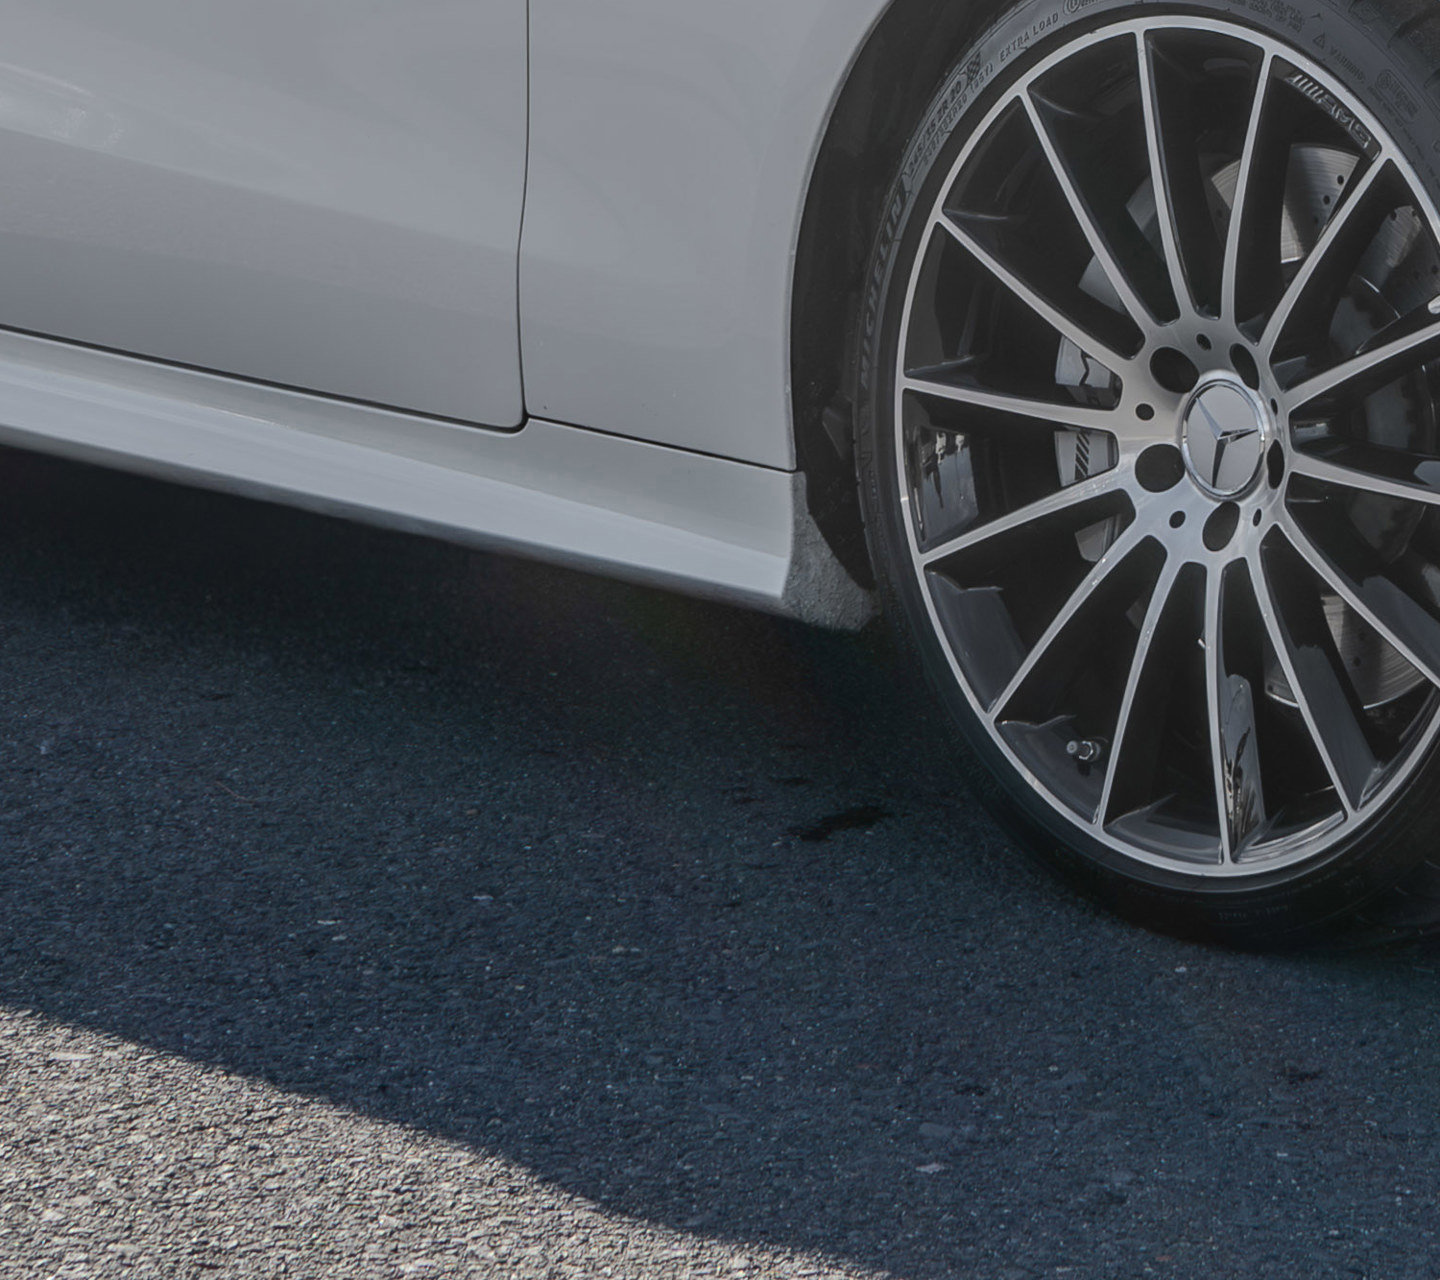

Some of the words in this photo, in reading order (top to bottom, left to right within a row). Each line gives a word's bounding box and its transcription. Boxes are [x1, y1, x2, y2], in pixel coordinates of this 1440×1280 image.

[999, 32, 1030, 62] EXTRA
[1033, 13, 1059, 35] LOAD
[860, 192, 903, 390] MICHELIN
